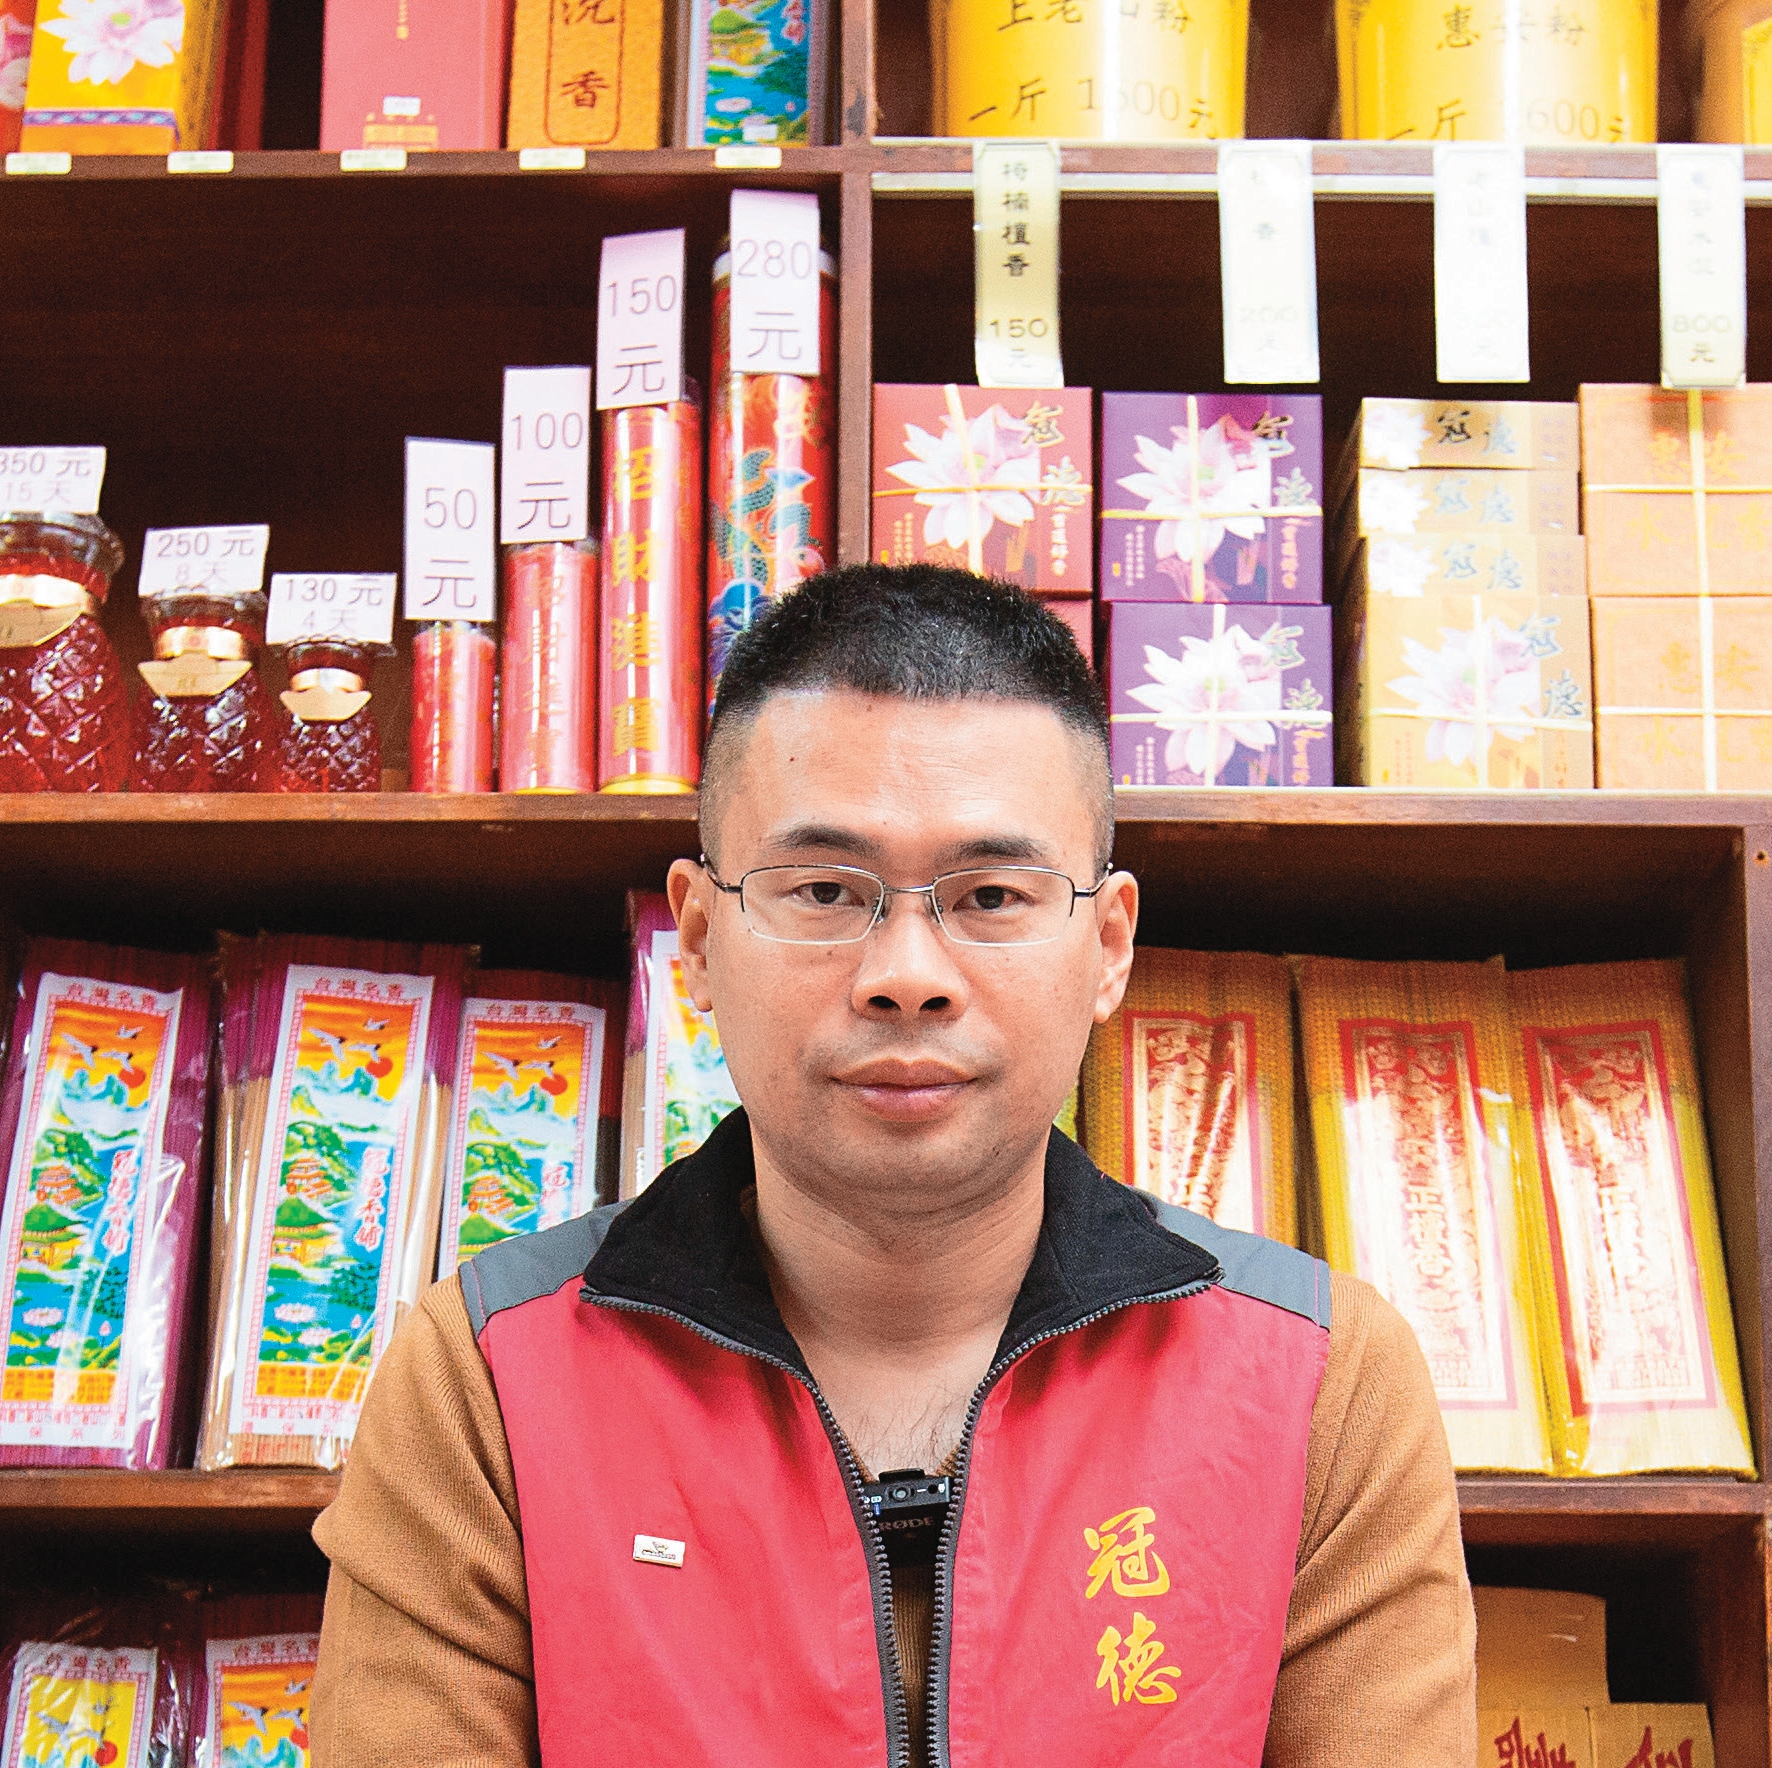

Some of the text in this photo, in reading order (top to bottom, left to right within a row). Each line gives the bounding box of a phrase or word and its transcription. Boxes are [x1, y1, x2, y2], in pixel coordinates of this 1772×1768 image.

[735, 238, 815, 280] 280
[604, 273, 678, 318] 150
[749, 310, 805, 362] 元
[989, 318, 1049, 339] 150
[1672, 313, 1732, 336] 800
[1689, 341, 1715, 365] 元
[611, 344, 667, 398] 元
[510, 411, 584, 451] 100
[56, 455, 92, 478] 元
[4, 479, 73, 506] 15 天
[517, 481, 571, 531] 元
[424, 487, 478, 530] 50
[156, 530, 256, 559] 250 元
[199, 561, 228, 587] 天
[422, 559, 477, 609] 元
[285, 578, 385, 607] 130 元
[301, 608, 359, 635] 4 天
[313, 976, 407, 999] 台灣名香
[485, 1002, 576, 1019] 台灣名香
[354, 1145, 392, 1255] 冠德香舖
[1082, 1506, 1182, 1707] 冠德
